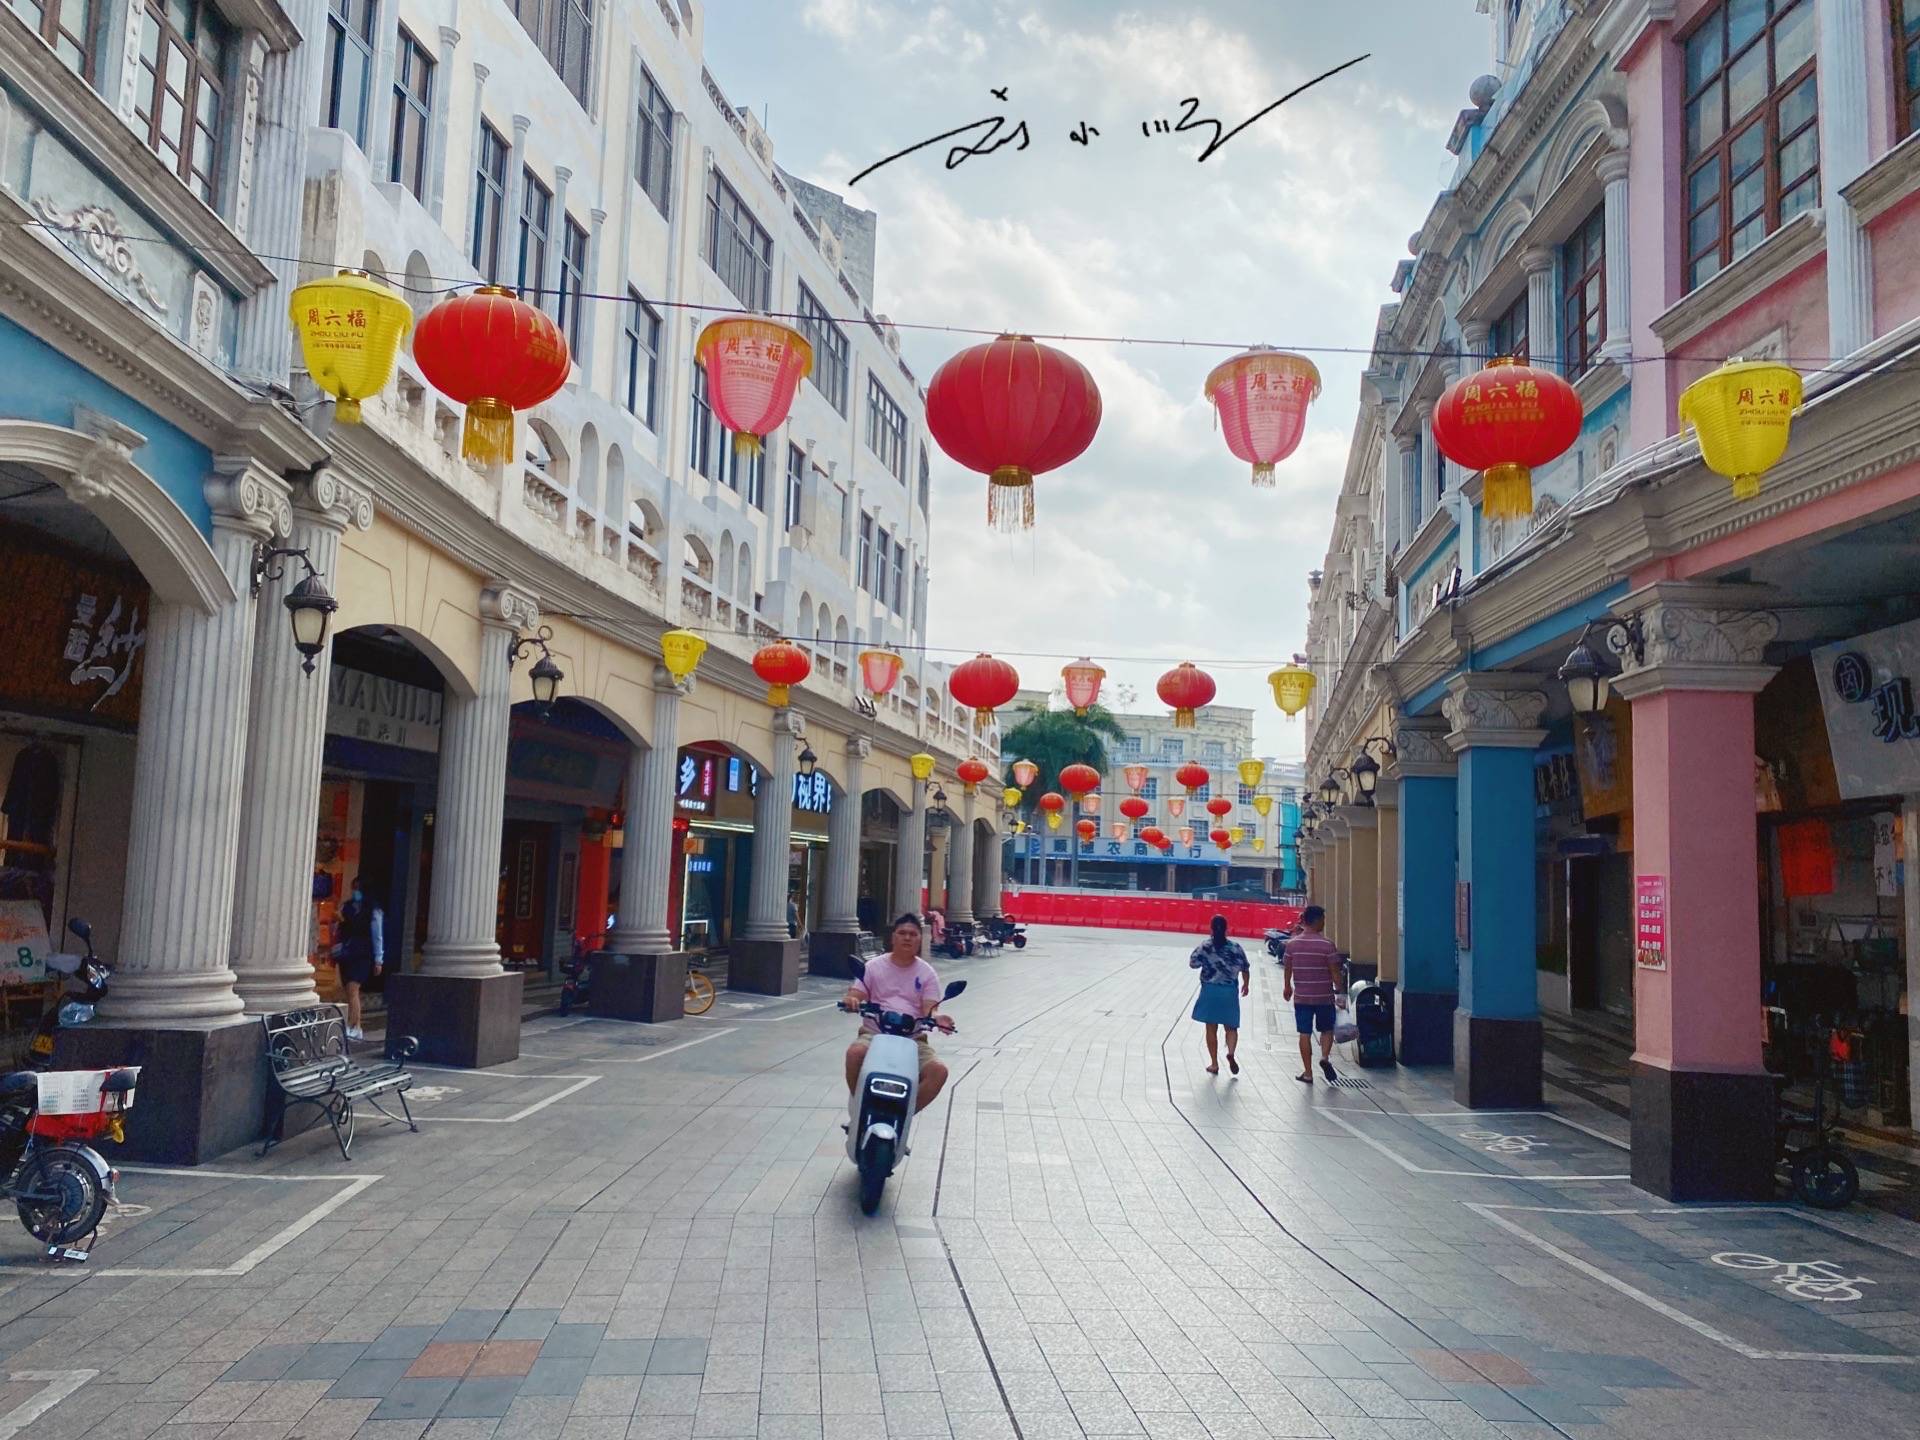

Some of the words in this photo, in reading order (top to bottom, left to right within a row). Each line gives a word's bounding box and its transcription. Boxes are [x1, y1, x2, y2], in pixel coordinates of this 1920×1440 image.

[307, 307, 367, 329] 周六福
[725, 336, 782, 362] 周六福
[1251, 372, 1305, 394] 周六福
[1463, 380, 1539, 404] 周六福
[1737, 387, 1790, 406] 周六福
[1871, 677, 1920, 743] 现
[792, 770, 831, 814] 视界
